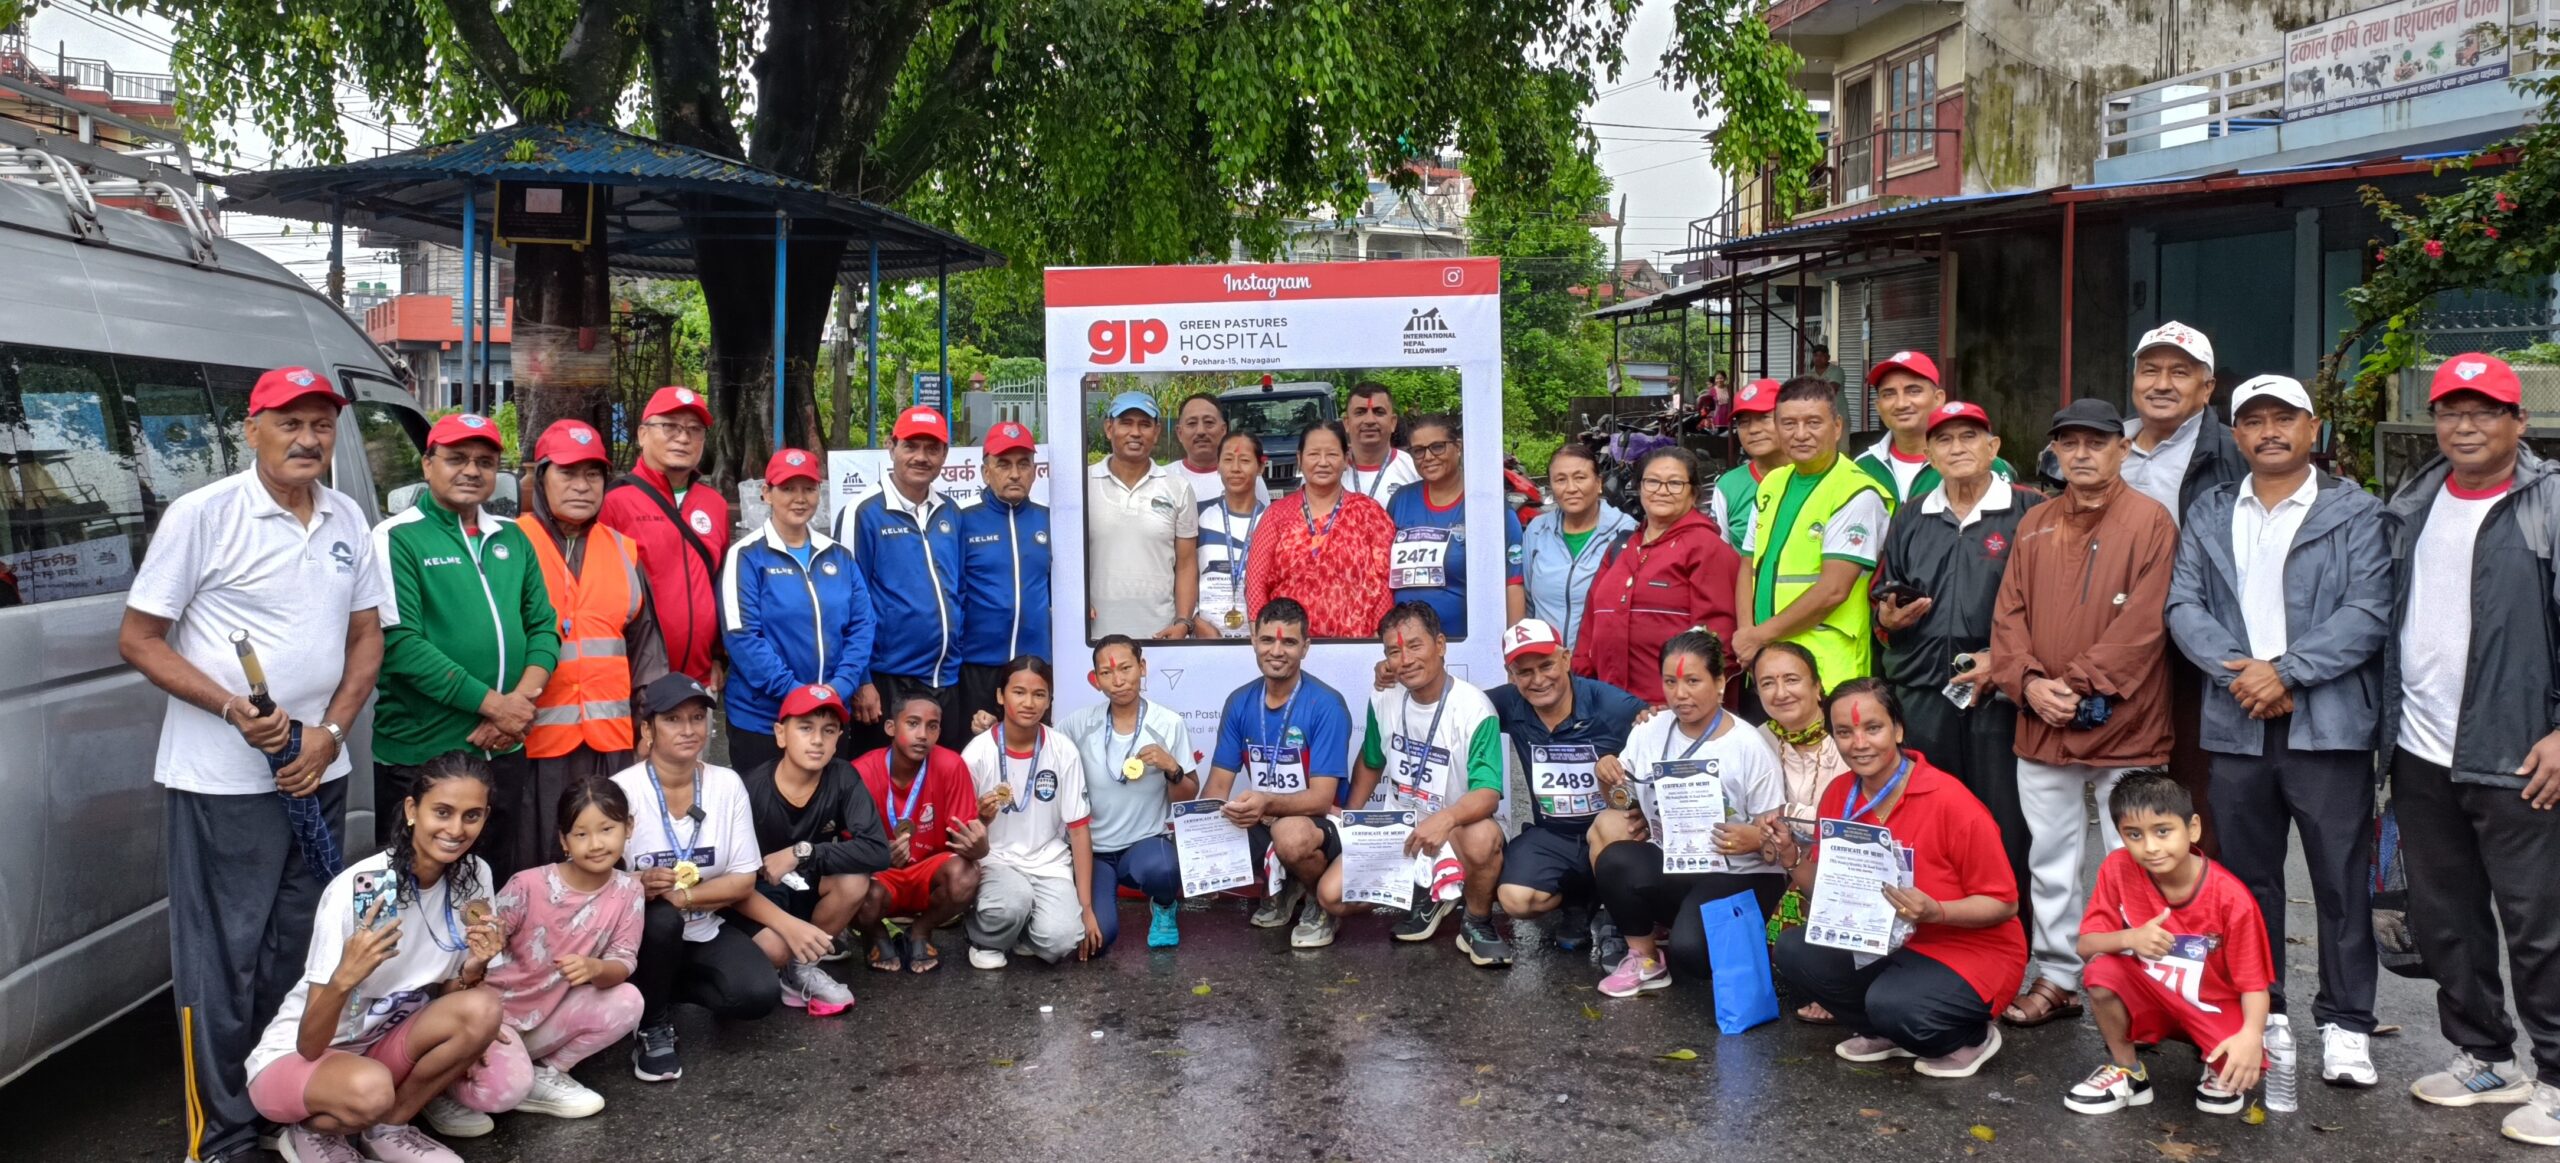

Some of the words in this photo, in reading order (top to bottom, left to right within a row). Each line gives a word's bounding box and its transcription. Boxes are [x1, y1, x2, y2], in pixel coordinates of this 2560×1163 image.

[2290, 35, 2328, 64] ढकाल
[2331, 20, 2360, 60] कृषि
[2363, 19, 2390, 46] तथा
[2394, 1, 2458, 42] पशुपालन
[1223, 273, 1312, 298] Instagram
[1179, 319, 1221, 330] GREEN
[1224, 317, 1288, 329] PASTURES
[1087, 318, 1169, 365] gp
[1180, 332, 1288, 351] HOSPITAL
[1192, 357, 1239, 366] Pokhara-15,
[1240, 356, 1281, 365] Nayagaun
[941, 459, 976, 483] खर्क
[1758, 494, 1771, 512] 3
[881, 527, 910, 536] KELME
[968, 534, 1000, 544] KELME
[423, 556, 462, 567] KELME
[1397, 548, 1437, 565] 2471
[1257, 771, 1300, 789] 2483
[1399, 759, 1433, 783] 525
[1541, 772, 1595, 789] 2489
[1830, 844, 1862, 854] CERTIFICATE
[2141, 962, 2188, 994] 71
